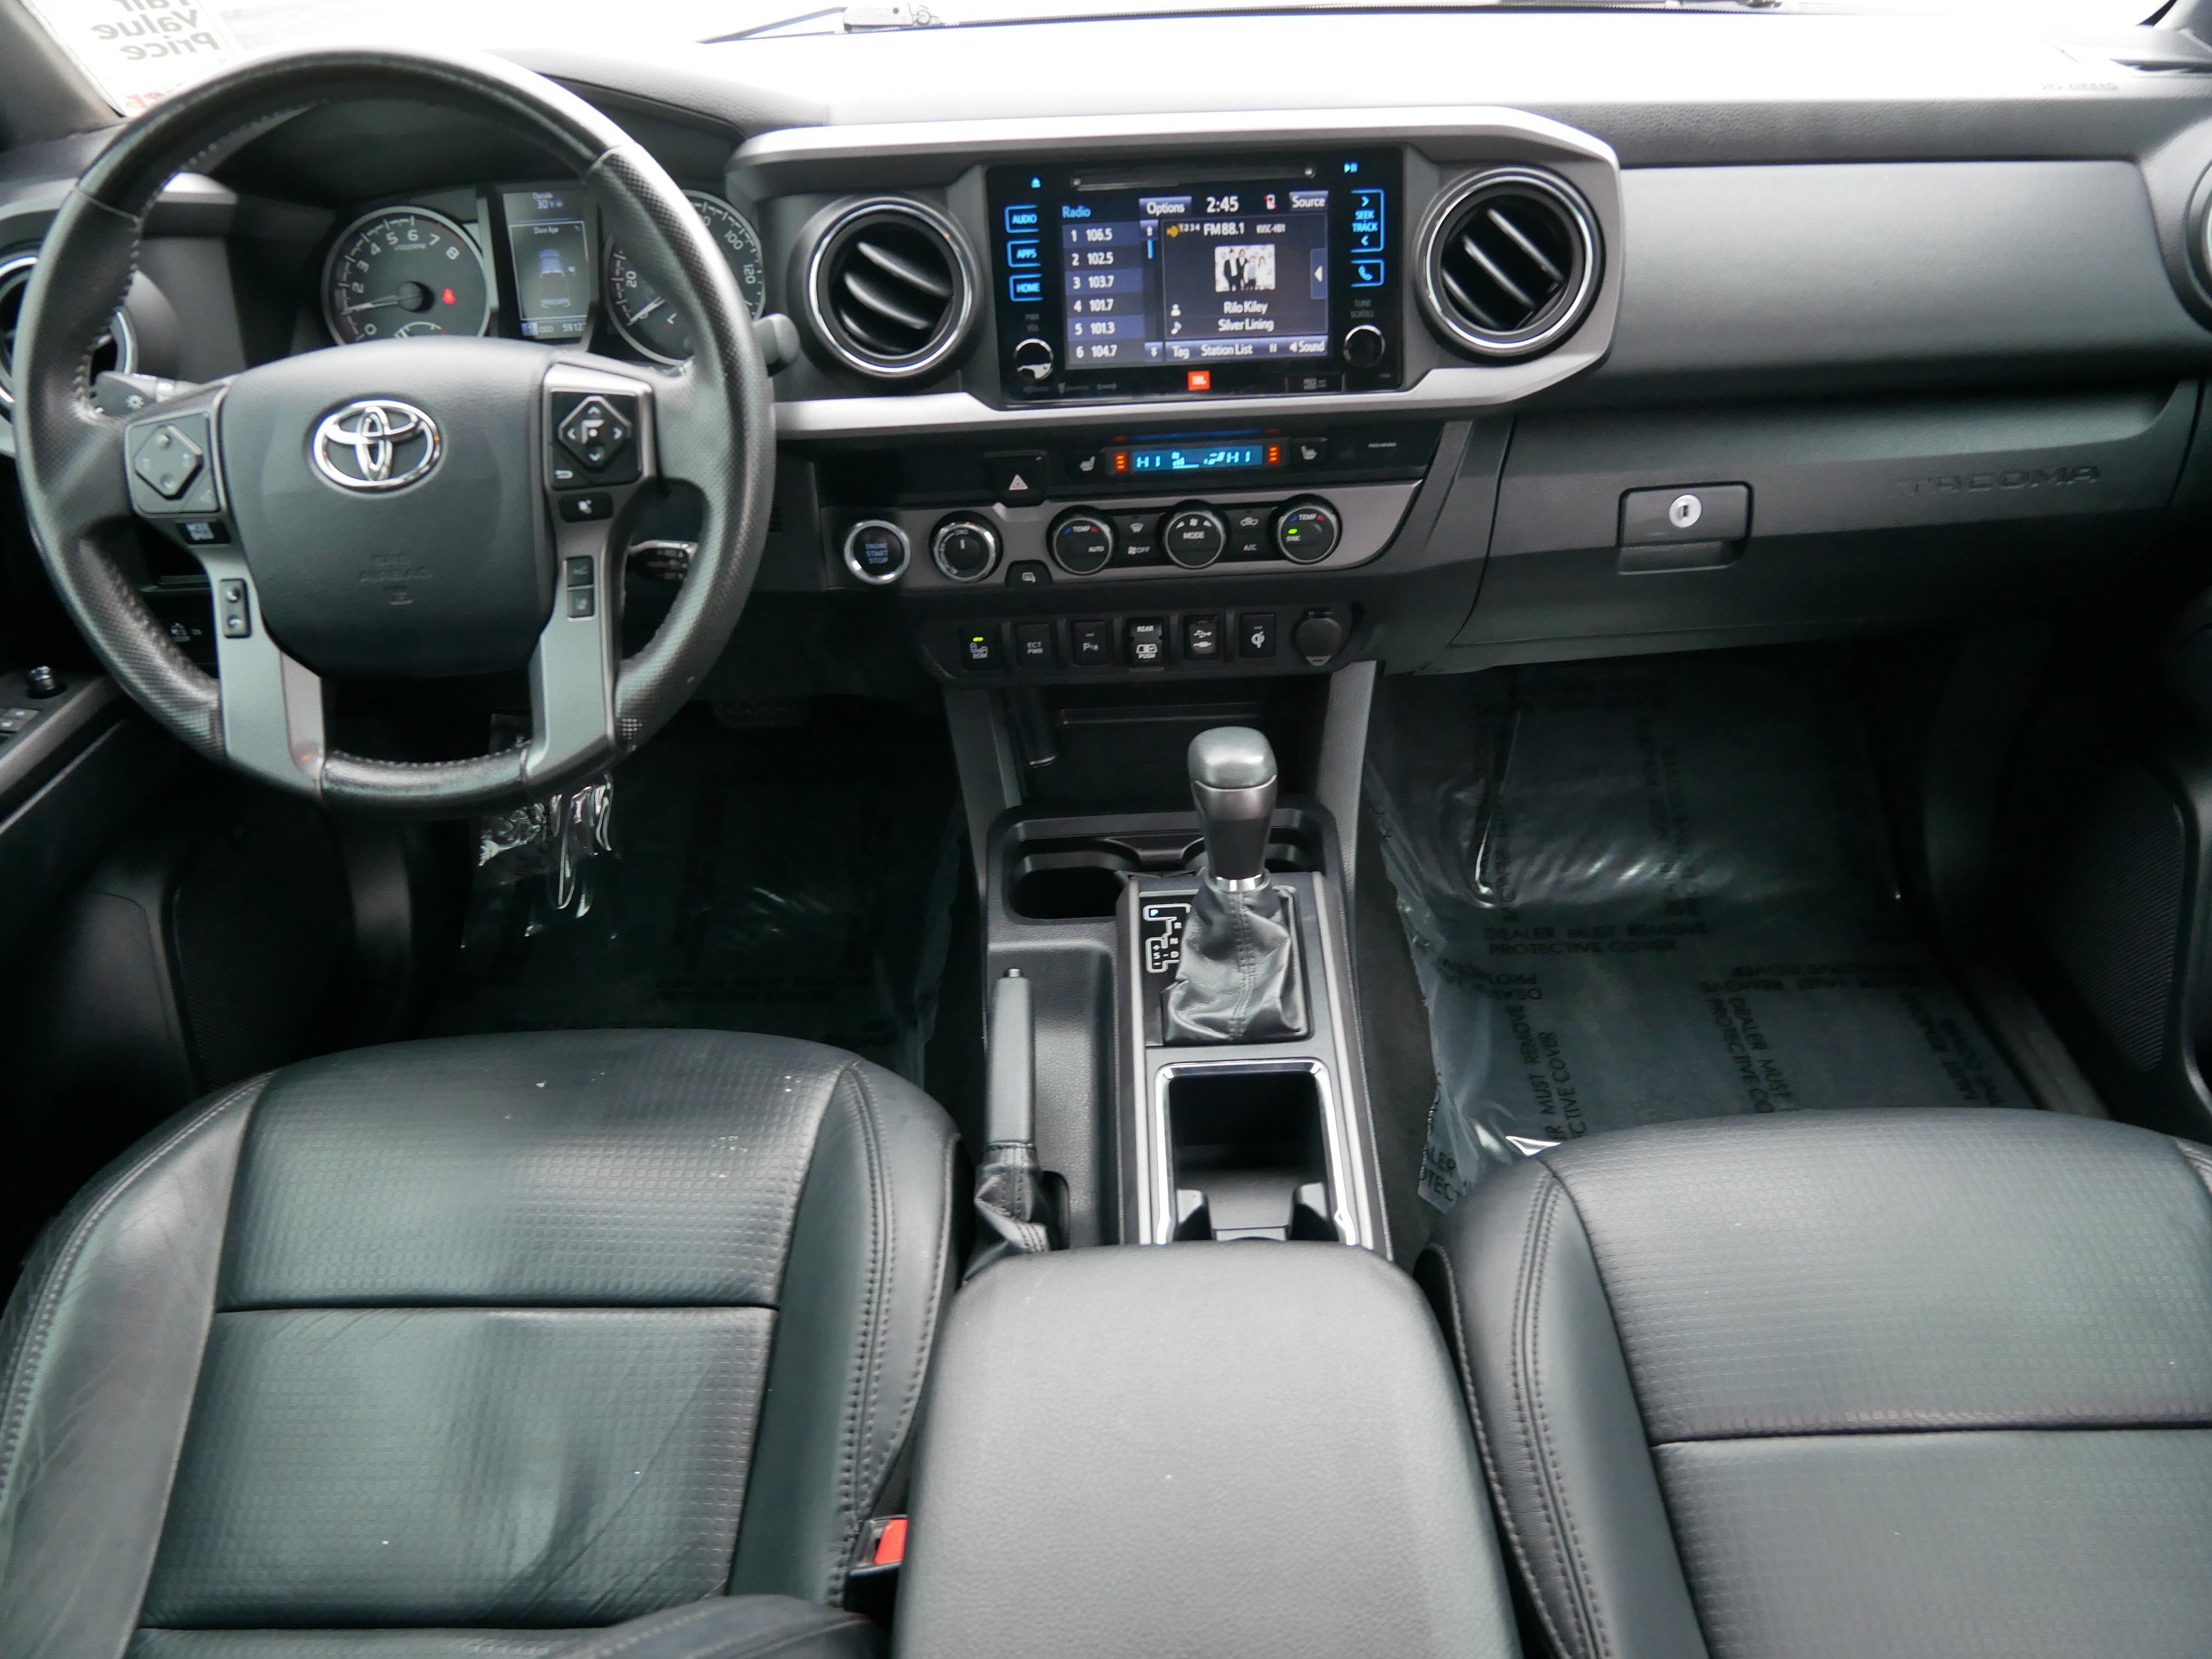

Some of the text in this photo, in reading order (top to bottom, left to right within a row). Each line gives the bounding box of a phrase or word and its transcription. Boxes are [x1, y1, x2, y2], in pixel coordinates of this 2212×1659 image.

[1146, 201, 1185, 216] Options
[1207, 196, 1239, 214] 2:45
[1292, 195, 1326, 209] Source
[1062, 205, 1091, 218] Radio
[1355, 209, 1375, 220] SEEK
[1012, 214, 1038, 224] AUDIO
[1352, 222, 1378, 233] TRACK
[386, 231, 399, 246] 5
[407, 229, 419, 241] 6
[429, 233, 441, 246] 7
[724, 229, 744, 250] 100
[1071, 228, 1113, 242] 1 106.5
[370, 243, 382, 256] 4
[446, 246, 460, 260] 8
[1016, 248, 1037, 259] APPS
[1072, 251, 1114, 266] 2 102.5
[357, 260, 370, 273] 3
[626, 270, 637, 289] 20
[743, 263, 756, 285] 120
[1016, 283, 1040, 293] HOME
[1073, 275, 1114, 290] 3 103.7
[1074, 298, 1114, 312] 4 101.7
[1224, 300, 1268, 315] Rilo Kiley
[364, 324, 377, 336] 0
[1075, 322, 1115, 335] 5 101.3
[1218, 318, 1274, 333] Silver Lining
[1076, 344, 1118, 358] 6 104.7
[1172, 340, 1325, 359] Tag Station List Sound
[1899, 465, 2101, 497] TACOMA
[1183, 531, 1205, 539] MODE
[1489, 941, 1604, 955] PROTECTIVE
[1507, 1004, 1541, 1064] REMOVE
[1539, 1031, 1571, 1083] COVER
[1529, 1073, 1557, 1115] MUST
